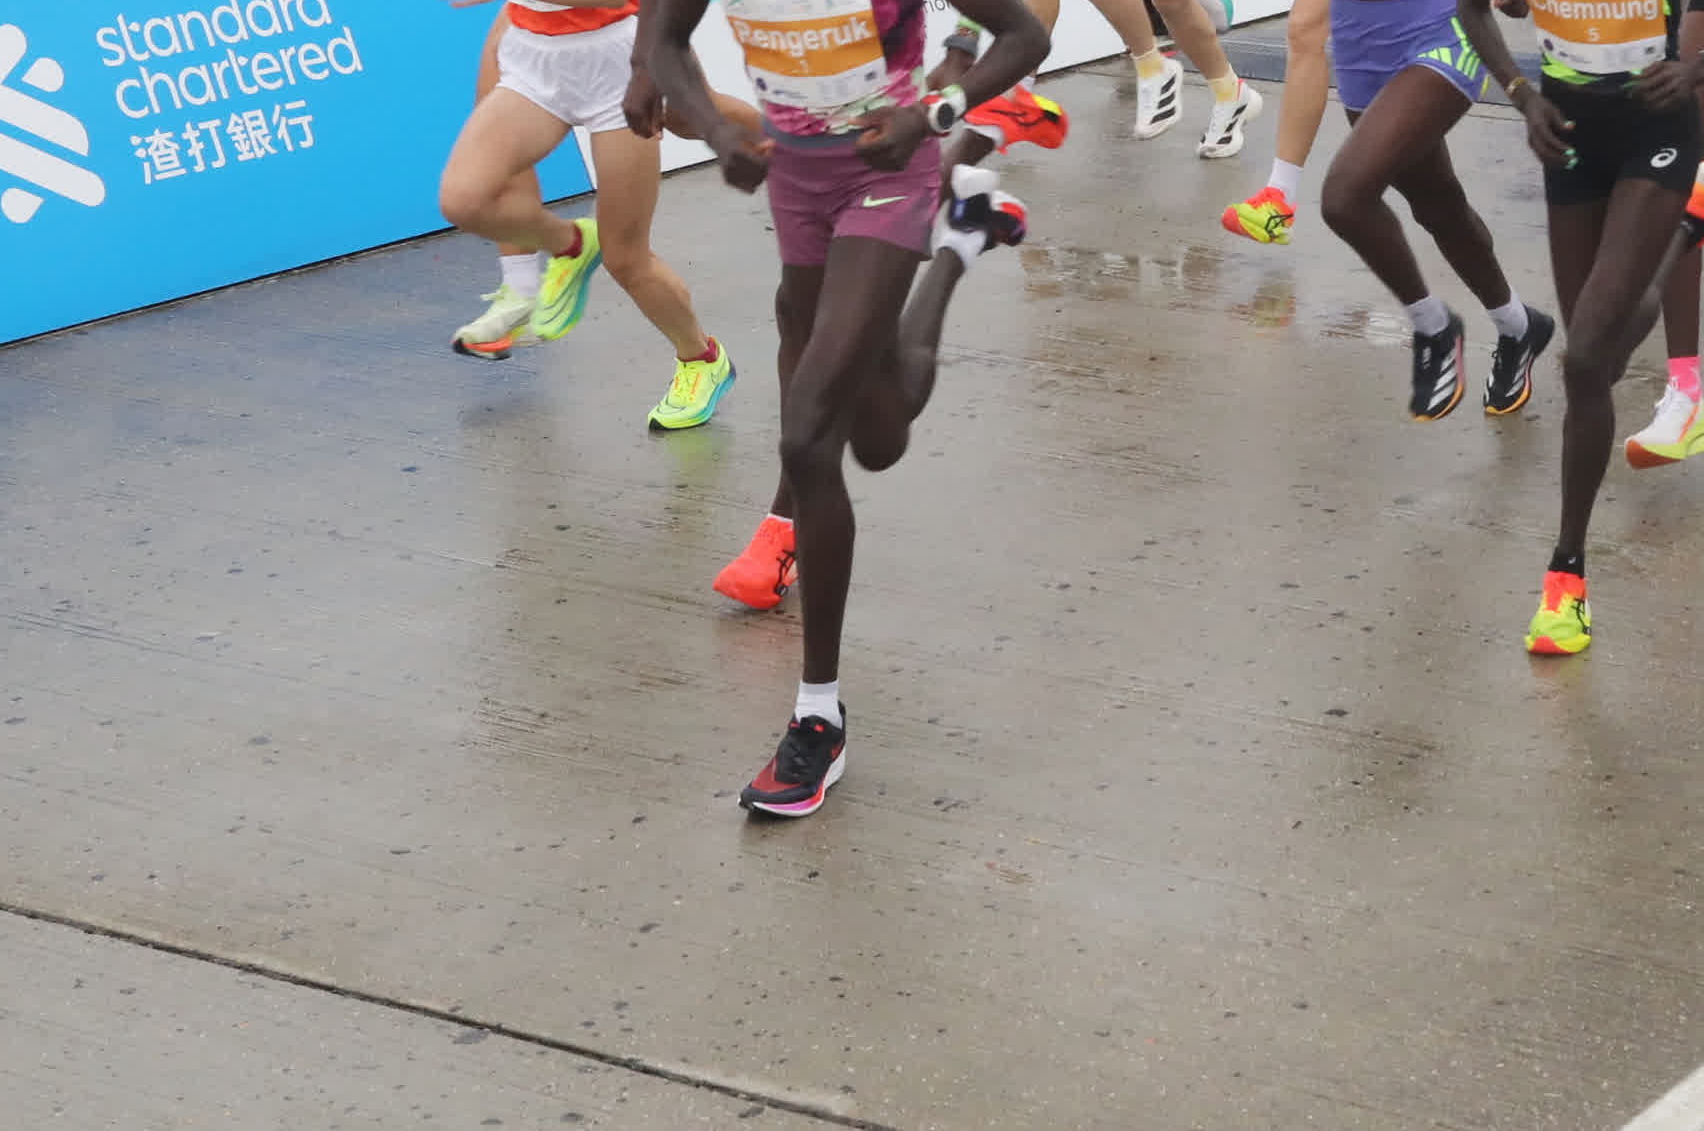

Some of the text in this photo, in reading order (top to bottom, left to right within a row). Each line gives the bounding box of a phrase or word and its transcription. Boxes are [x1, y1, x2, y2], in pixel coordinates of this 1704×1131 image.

[734, 16, 872, 57] Rengeruk
[1587, 28, 1600, 42] 5
[115, 26, 363, 118] chartered
[130, 100, 315, 184] 渣打銀行
